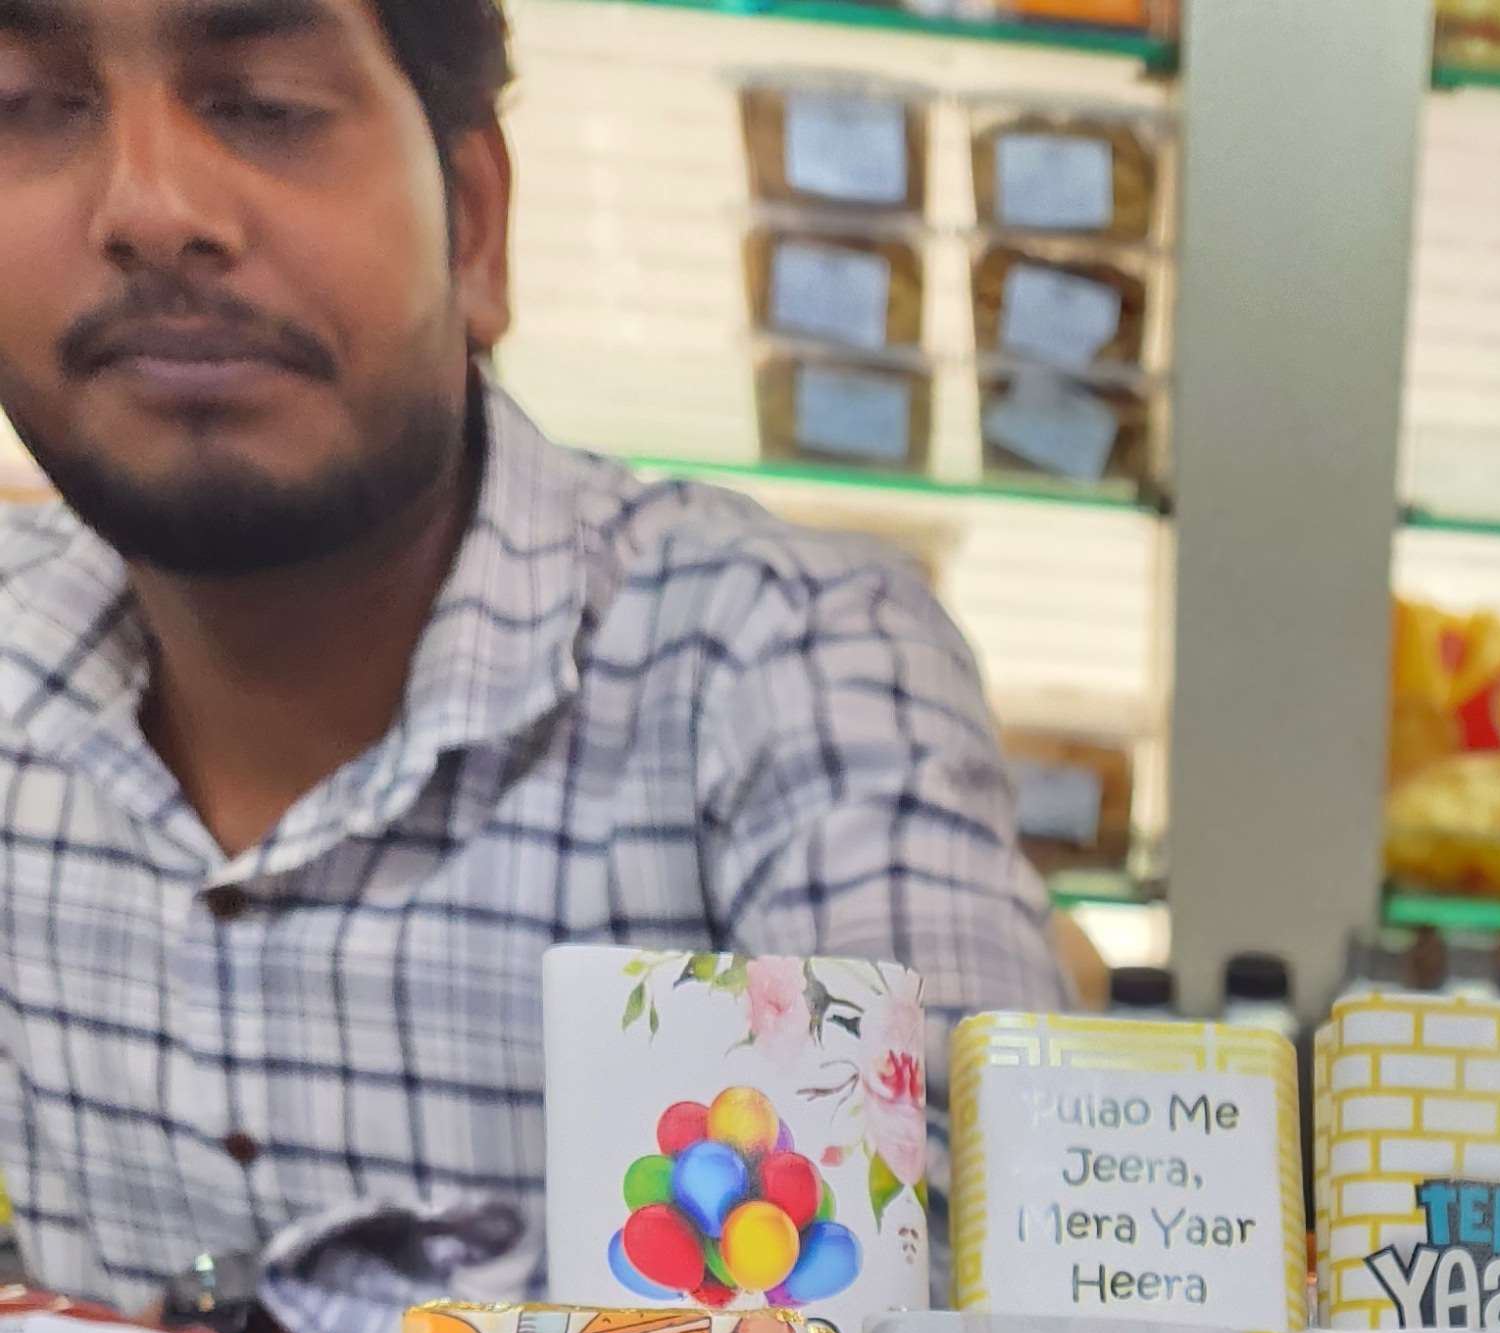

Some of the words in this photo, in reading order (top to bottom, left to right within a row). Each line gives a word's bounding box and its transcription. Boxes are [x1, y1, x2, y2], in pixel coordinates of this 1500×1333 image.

[1169, 1093, 1240, 1135] Me
[1061, 1146, 1204, 1189] Jeera,
[1151, 1205, 1257, 1250] Yaar
[1071, 1262, 1208, 1304] Heera
